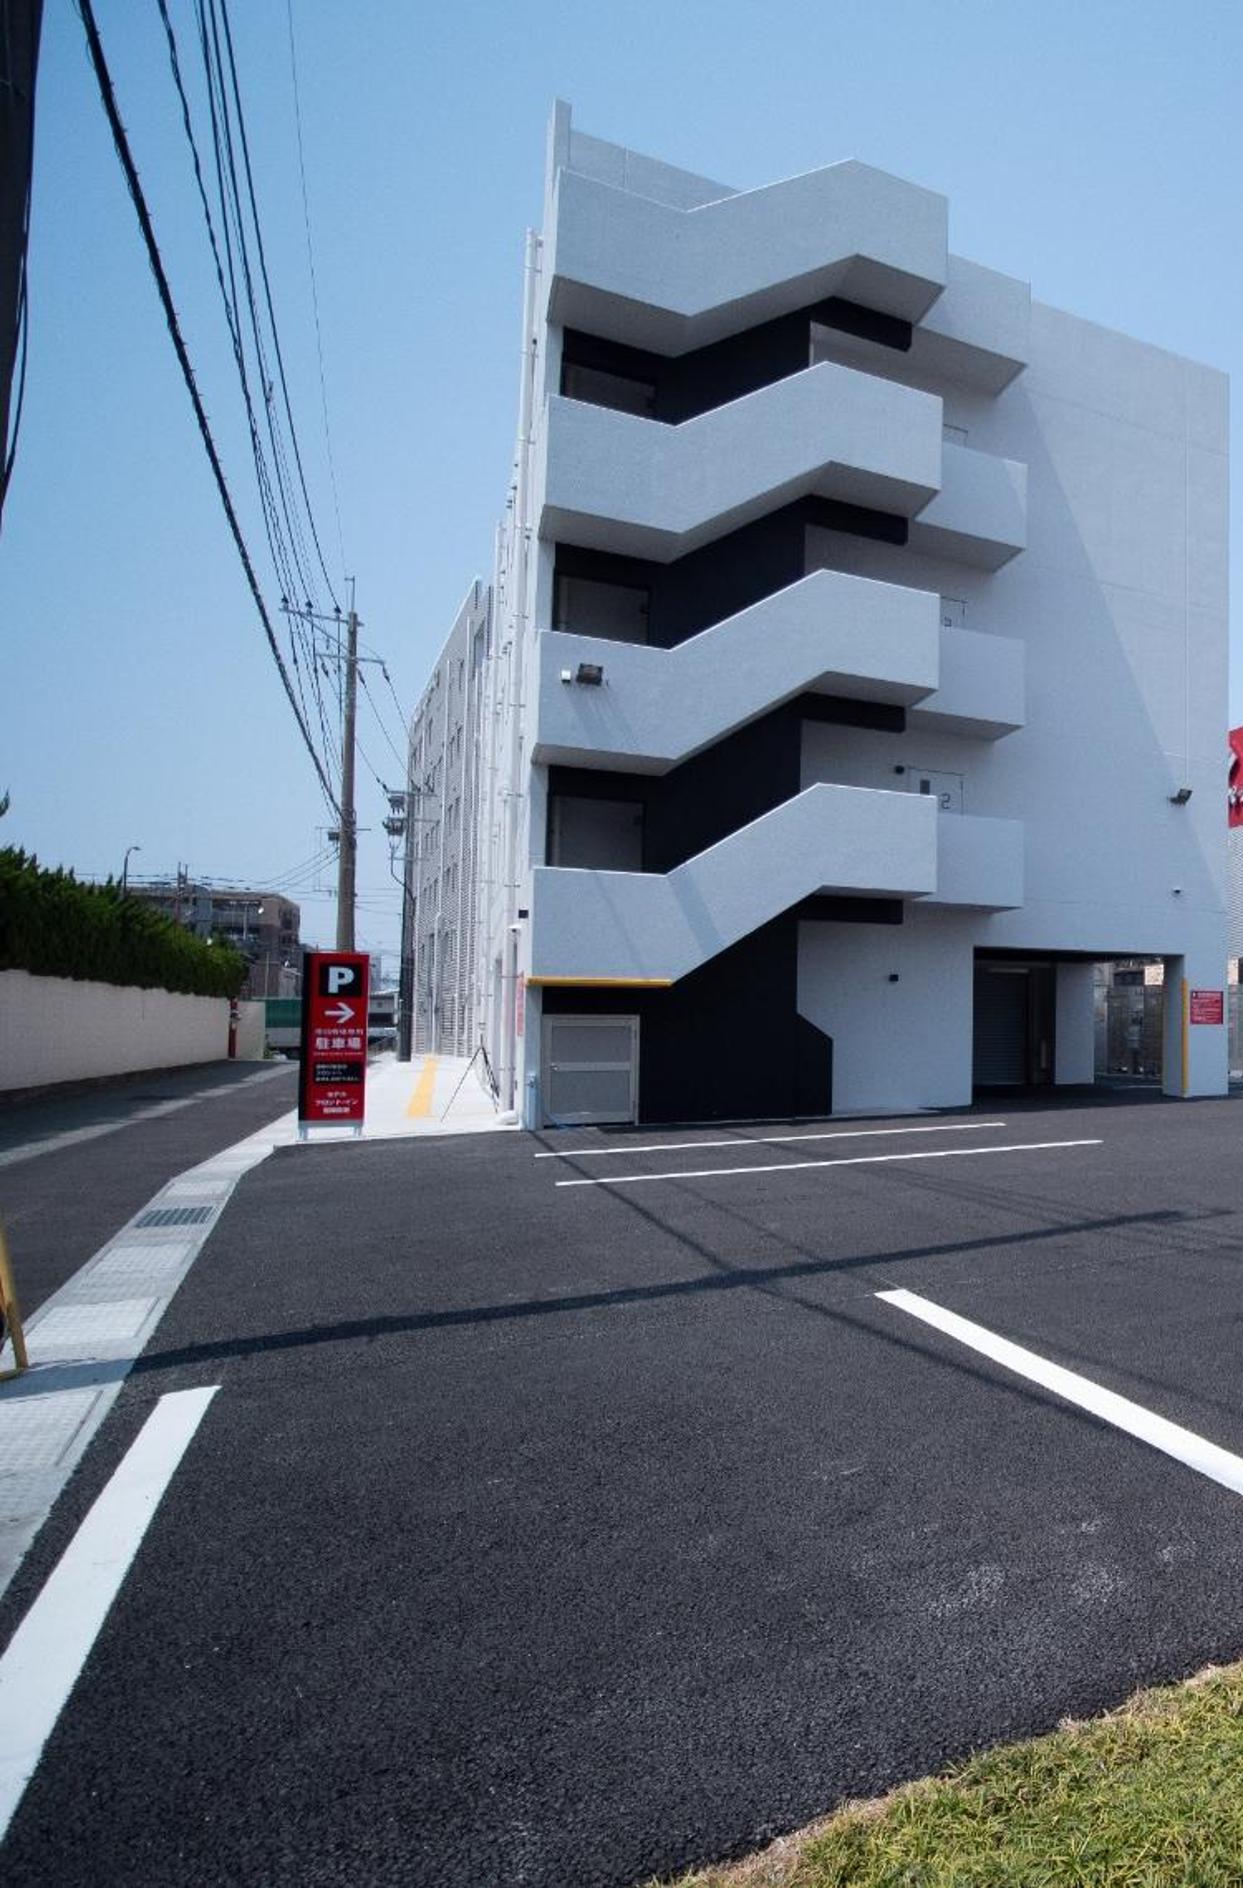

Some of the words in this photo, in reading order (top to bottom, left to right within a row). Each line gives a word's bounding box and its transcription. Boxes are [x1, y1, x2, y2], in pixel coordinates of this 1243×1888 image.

[328, 966, 355, 994] P
[316, 1037, 361, 1050] 駐車場
